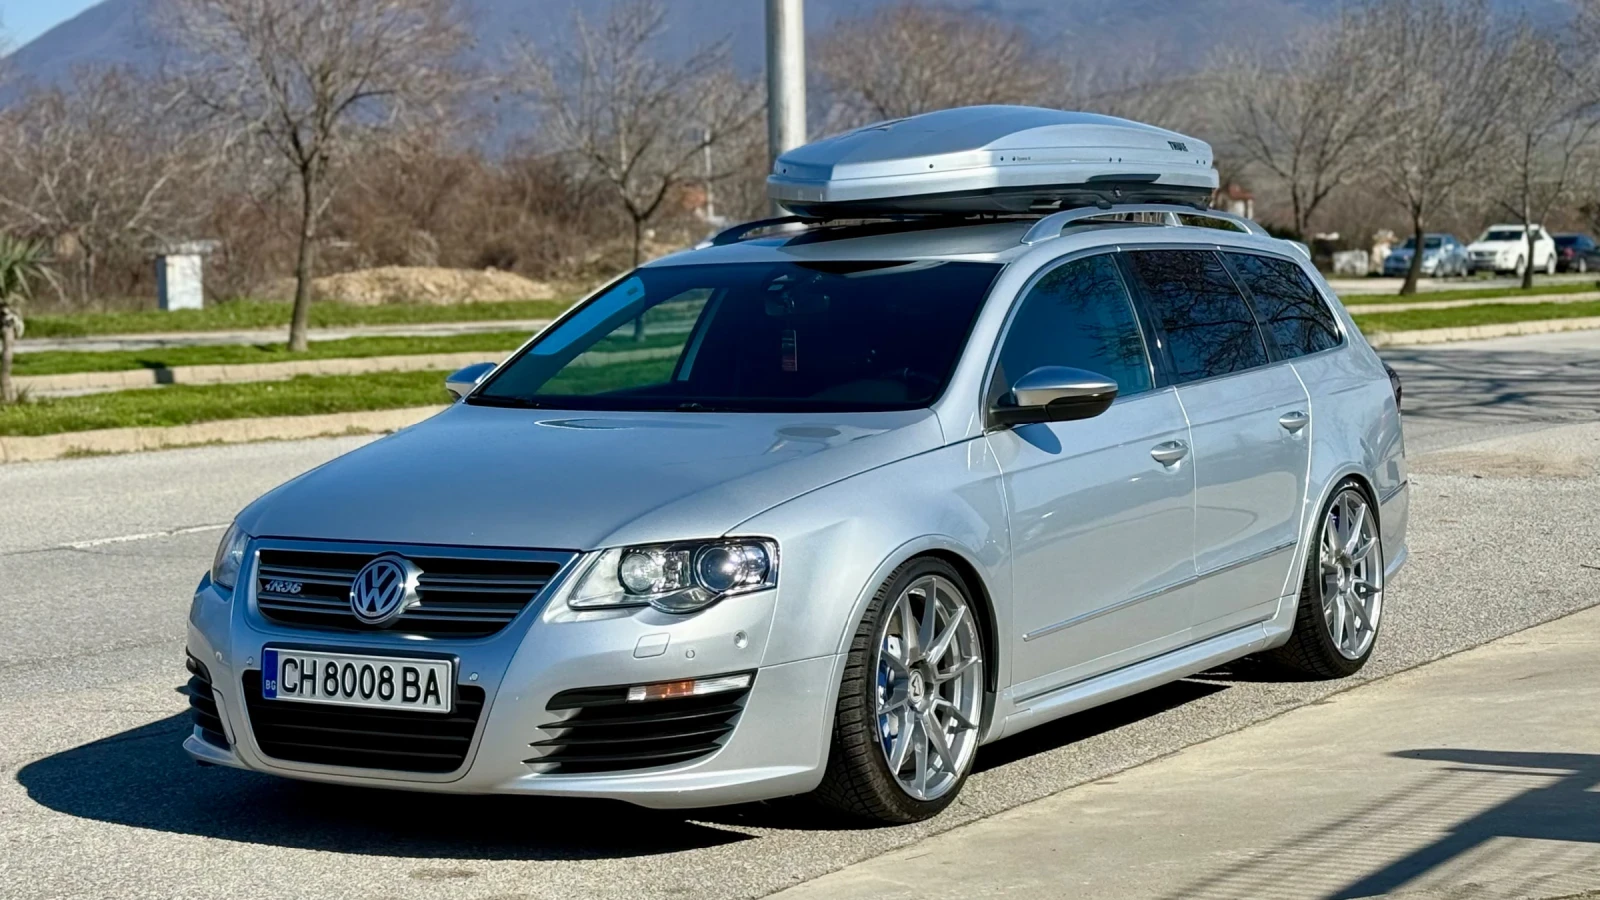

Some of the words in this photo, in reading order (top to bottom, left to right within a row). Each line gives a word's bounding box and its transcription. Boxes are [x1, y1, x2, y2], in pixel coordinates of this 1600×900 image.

[353, 560, 402, 618] VW
[265, 679, 277, 691] BG
[281, 657, 317, 696] CH
[323, 661, 395, 701] 8008
[402, 666, 442, 705] BA
